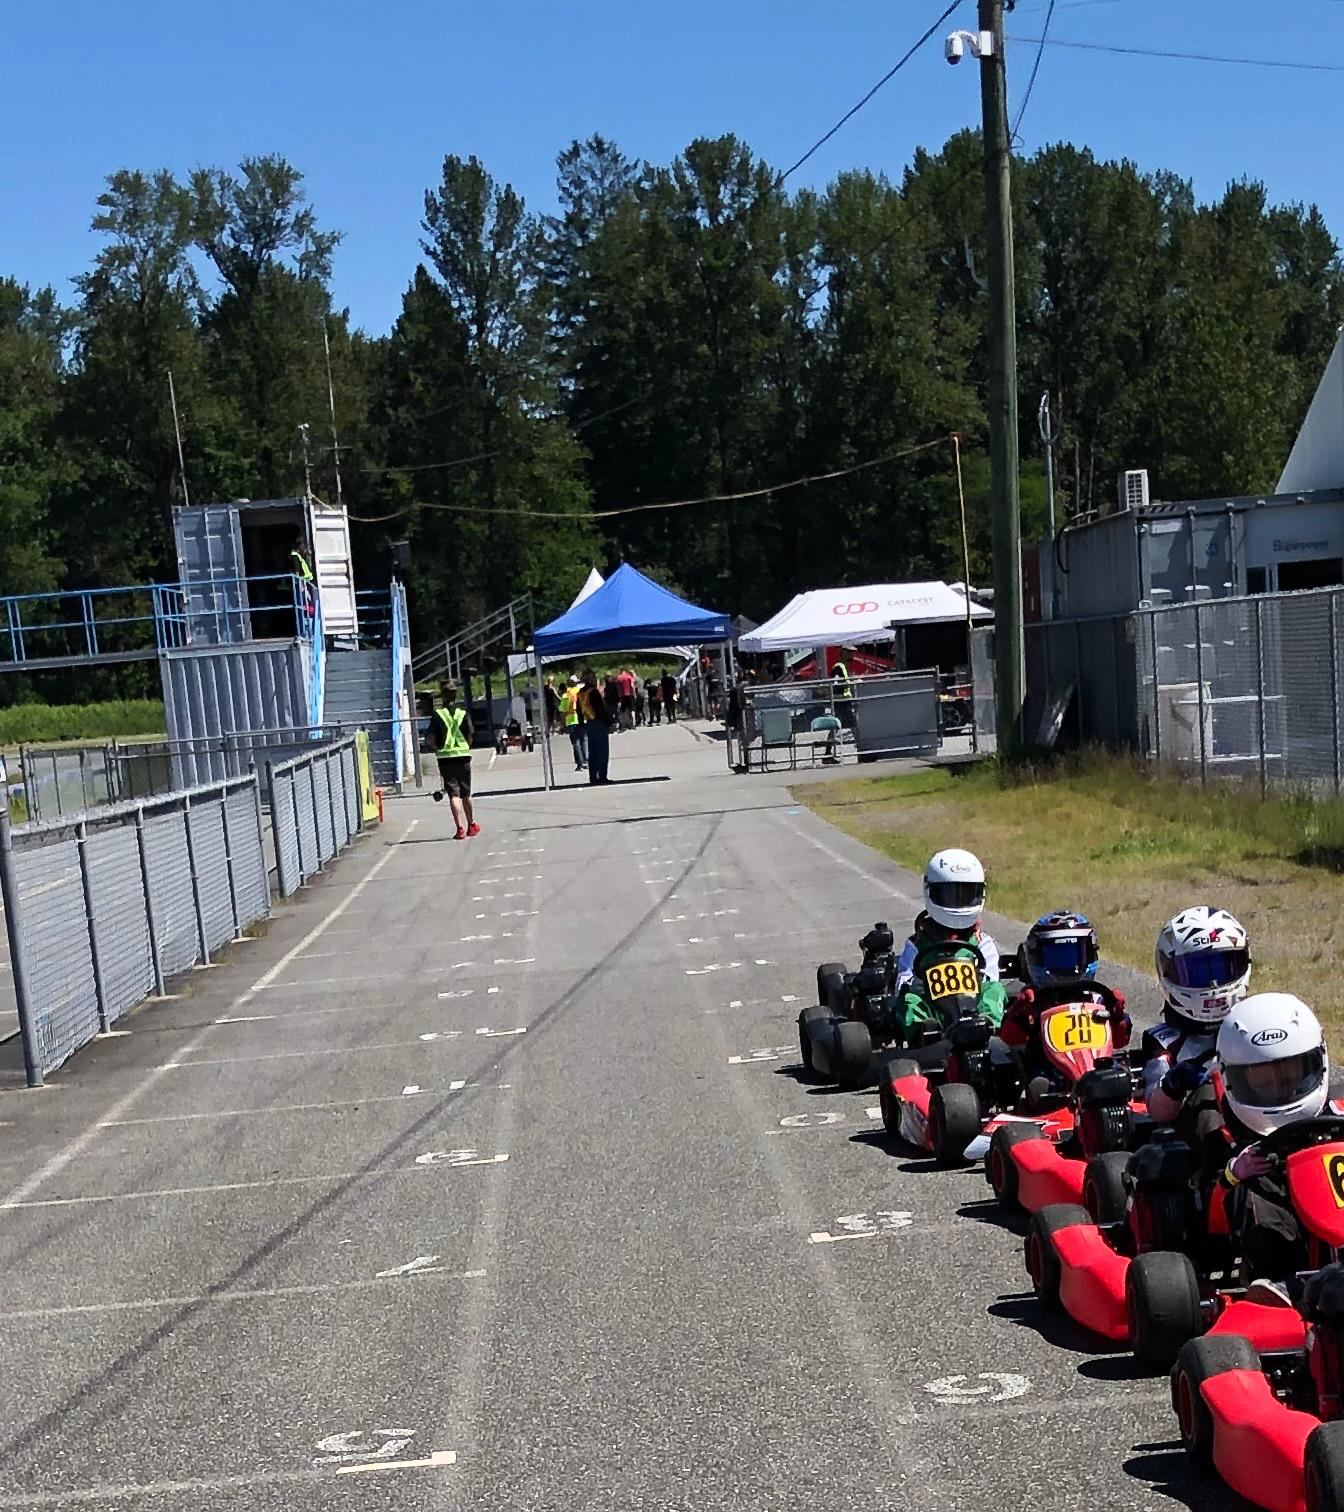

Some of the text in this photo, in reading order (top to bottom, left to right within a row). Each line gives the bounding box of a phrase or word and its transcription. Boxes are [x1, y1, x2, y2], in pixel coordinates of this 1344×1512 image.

[928, 964, 976, 997] 888
[1064, 1013, 1092, 1046] 20
[1255, 1029, 1285, 1044] Arai
